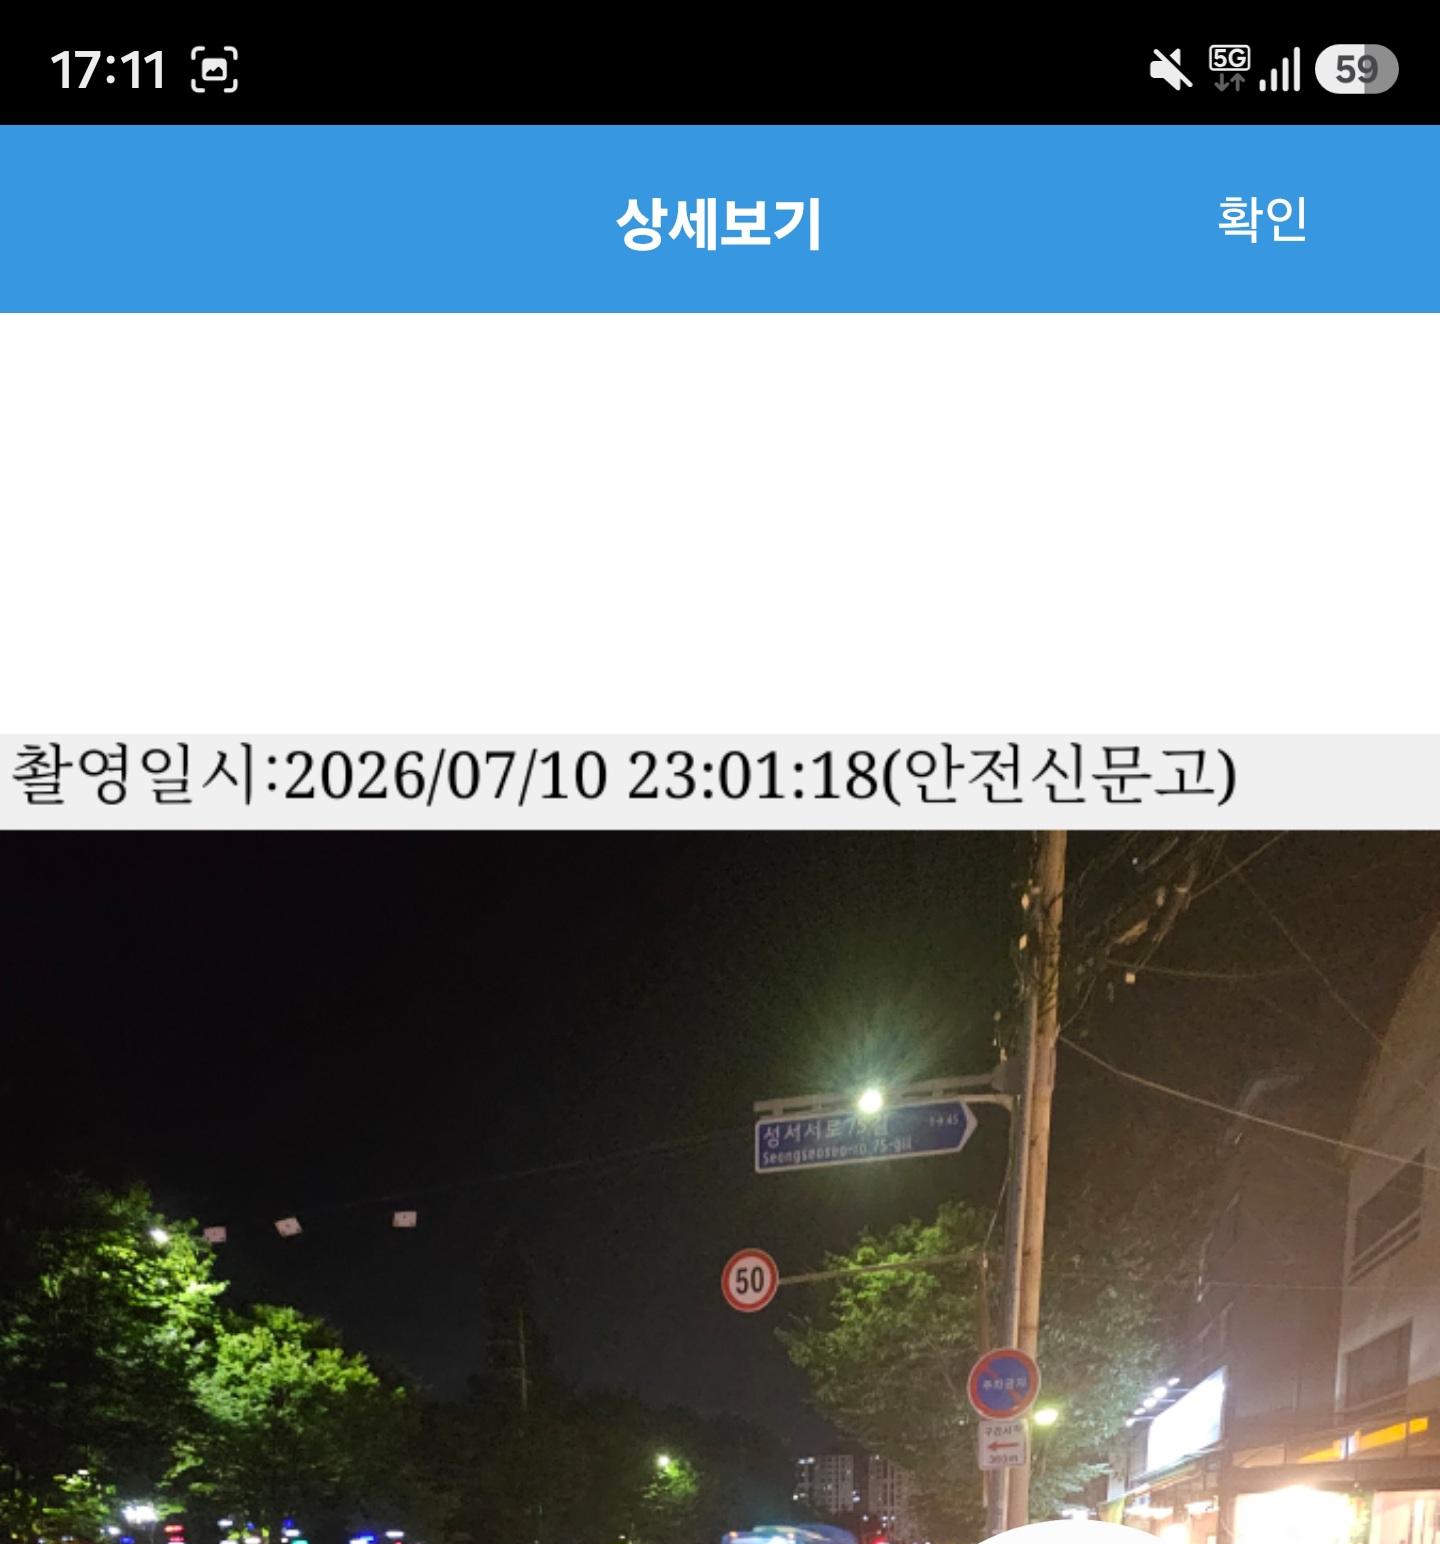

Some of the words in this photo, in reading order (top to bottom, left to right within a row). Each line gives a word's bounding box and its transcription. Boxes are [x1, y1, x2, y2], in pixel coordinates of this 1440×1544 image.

[50, 50, 164, 90] 17:11
[1213, 48, 1247, 68] 5G
[1336, 54, 1378, 84] 59
[616, 197, 821, 252] 상세보기
[1217, 195, 1308, 244] 확인
[735, 1265, 764, 1295] 50
